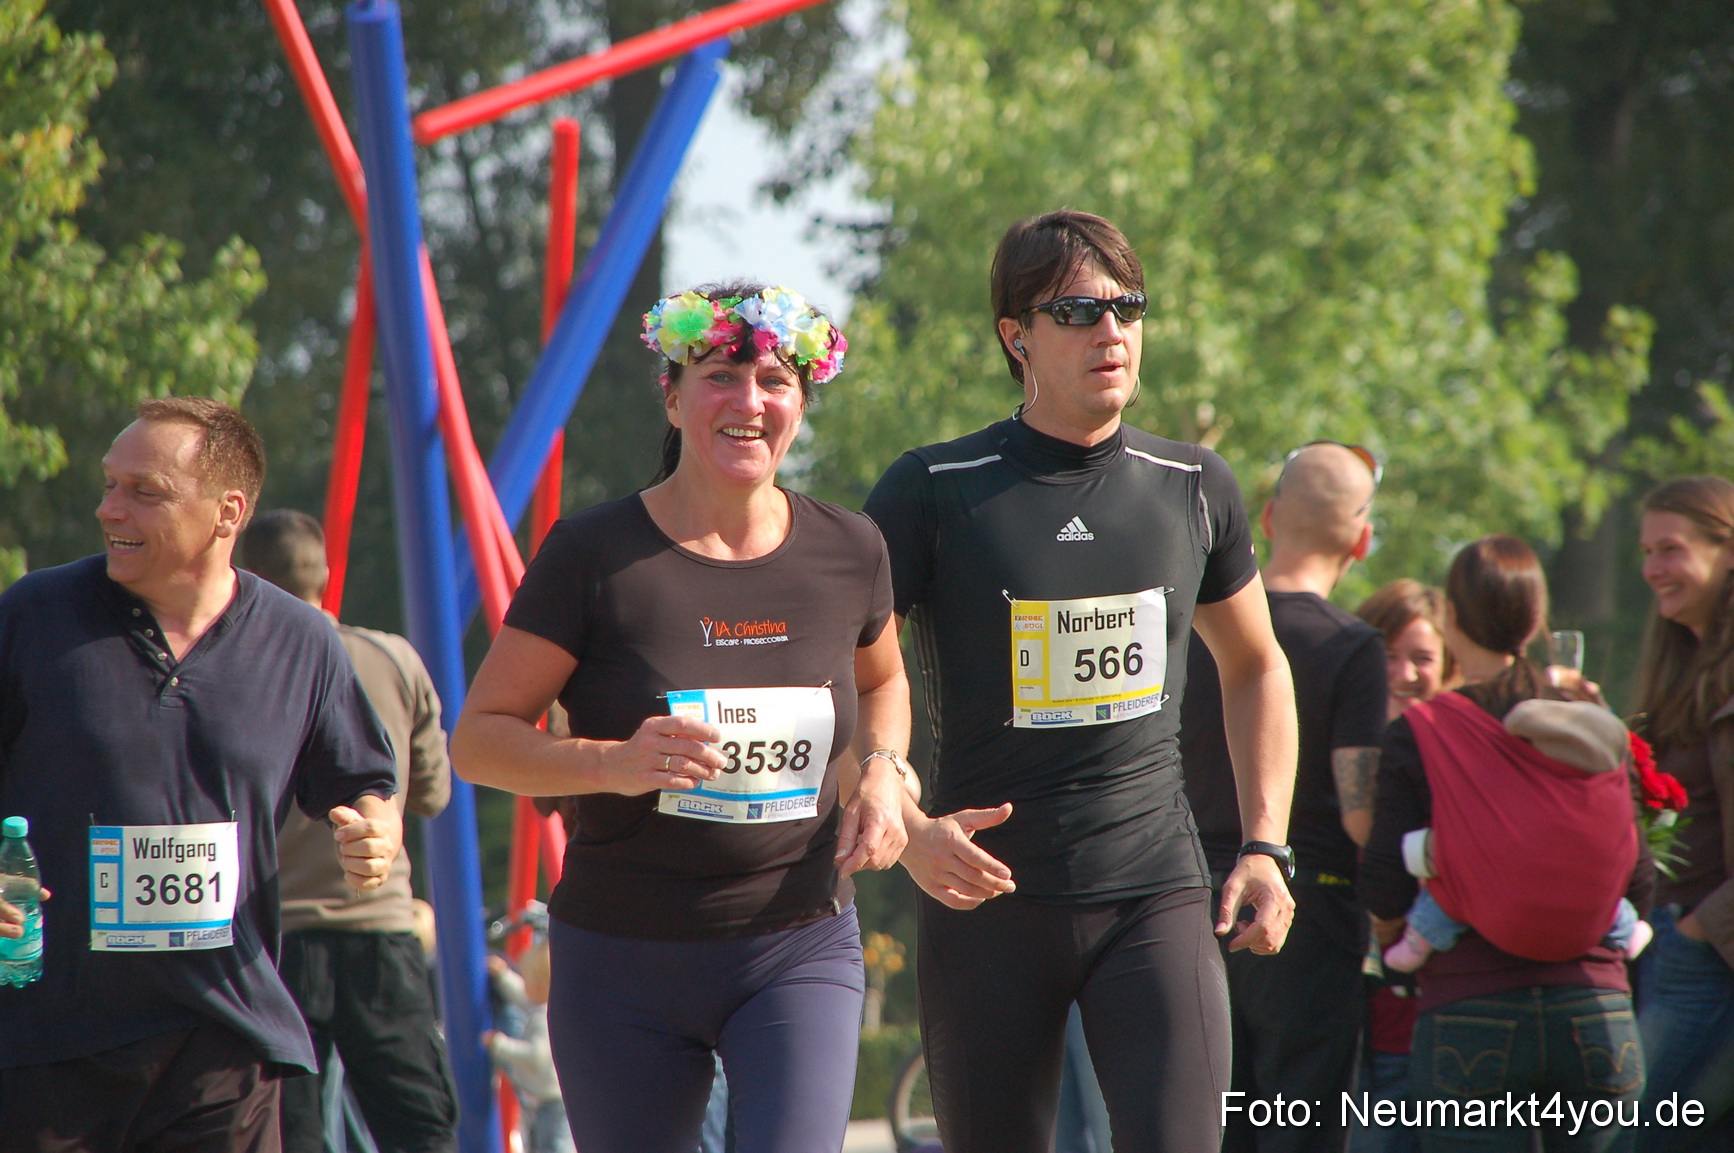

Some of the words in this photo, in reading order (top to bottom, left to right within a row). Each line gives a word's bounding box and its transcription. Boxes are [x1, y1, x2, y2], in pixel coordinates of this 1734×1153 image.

[1056, 531, 1095, 542] adidas
[734, 619, 787, 638] Christina
[1057, 607, 1136, 635] Norbert
[1020, 649, 1030, 667] D
[1073, 642, 1144, 683] 566
[717, 701, 757, 724] Ines
[1112, 692, 1160, 713] PFLEIDERER
[1031, 710, 1073, 721] BOCK
[721, 739, 812, 775] 3538
[677, 799, 724, 813] BOCK
[132, 836, 217, 864] Wolfgang
[100, 872, 109, 889] C
[135, 871, 221, 906] 3681
[106, 935, 146, 945] BOCK
